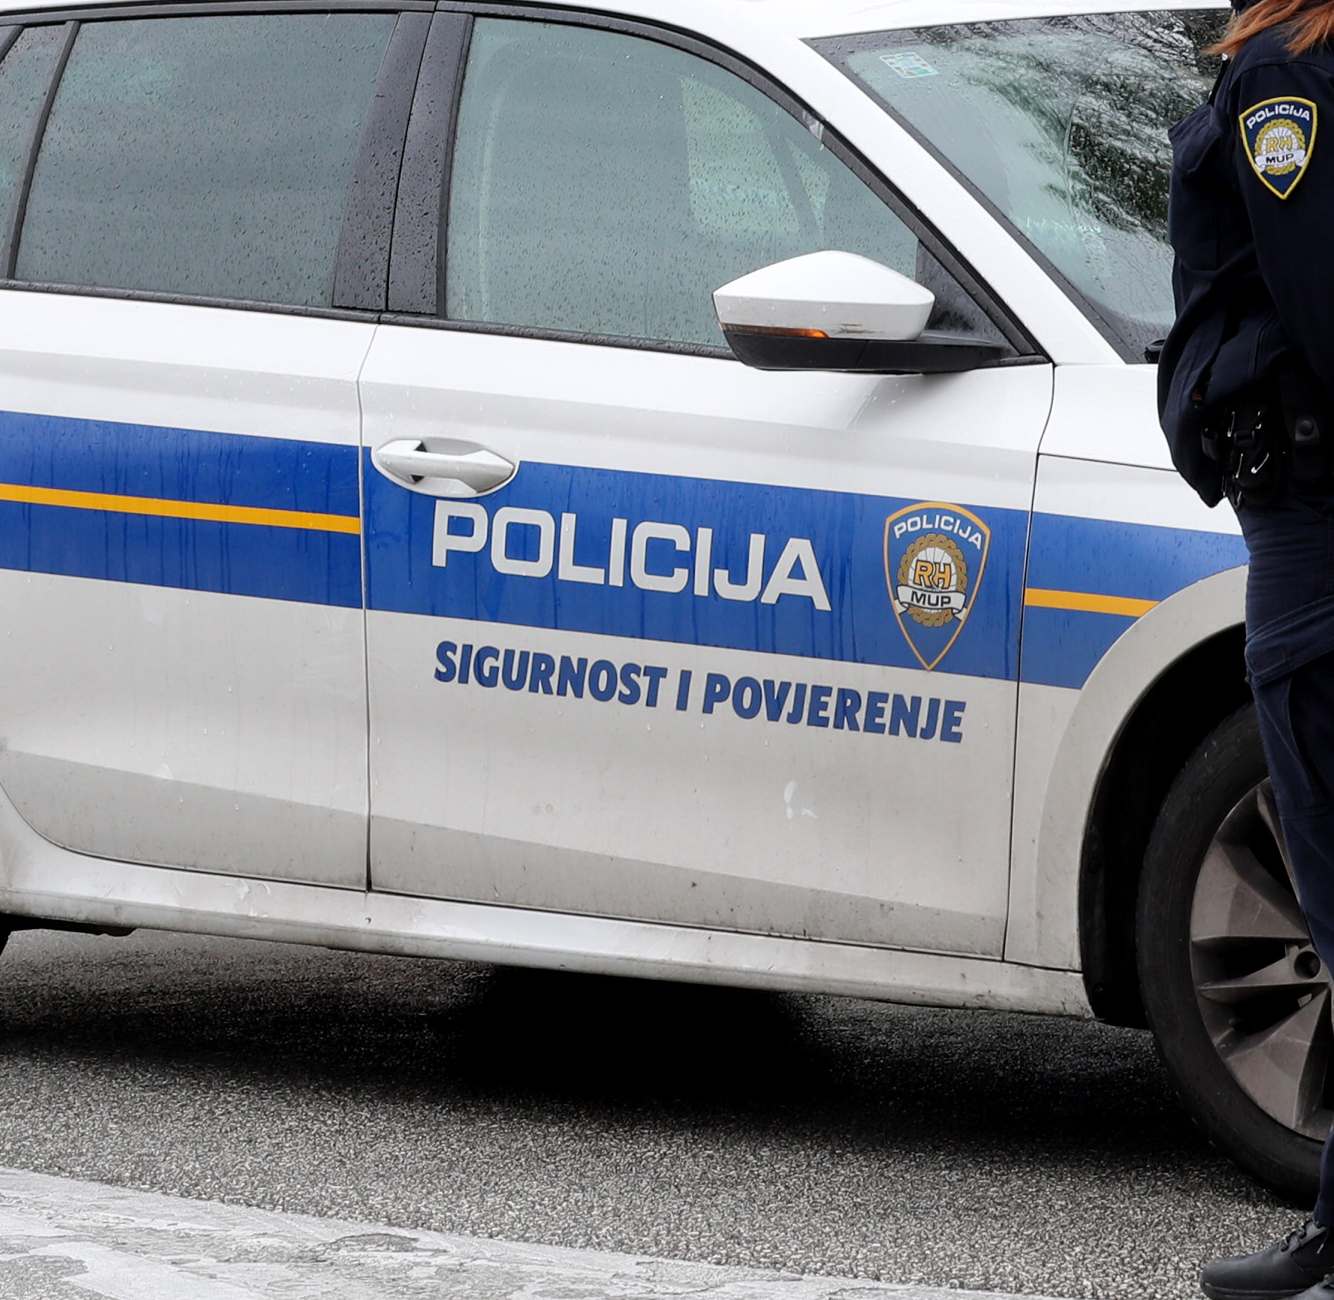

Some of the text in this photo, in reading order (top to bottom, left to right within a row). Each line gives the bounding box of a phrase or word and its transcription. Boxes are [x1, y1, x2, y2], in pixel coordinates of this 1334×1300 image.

[1246, 104, 1311, 129] POLICIJA
[1267, 136, 1293, 153] RH
[1266, 153, 1294, 164] MUP
[893, 514, 983, 550] POLICIJA
[431, 500, 832, 611] POLICIJA
[914, 560, 952, 589] RH
[911, 591, 952, 607] MUP
[434, 640, 967, 744] SIGURNOST I POVJERENJE
